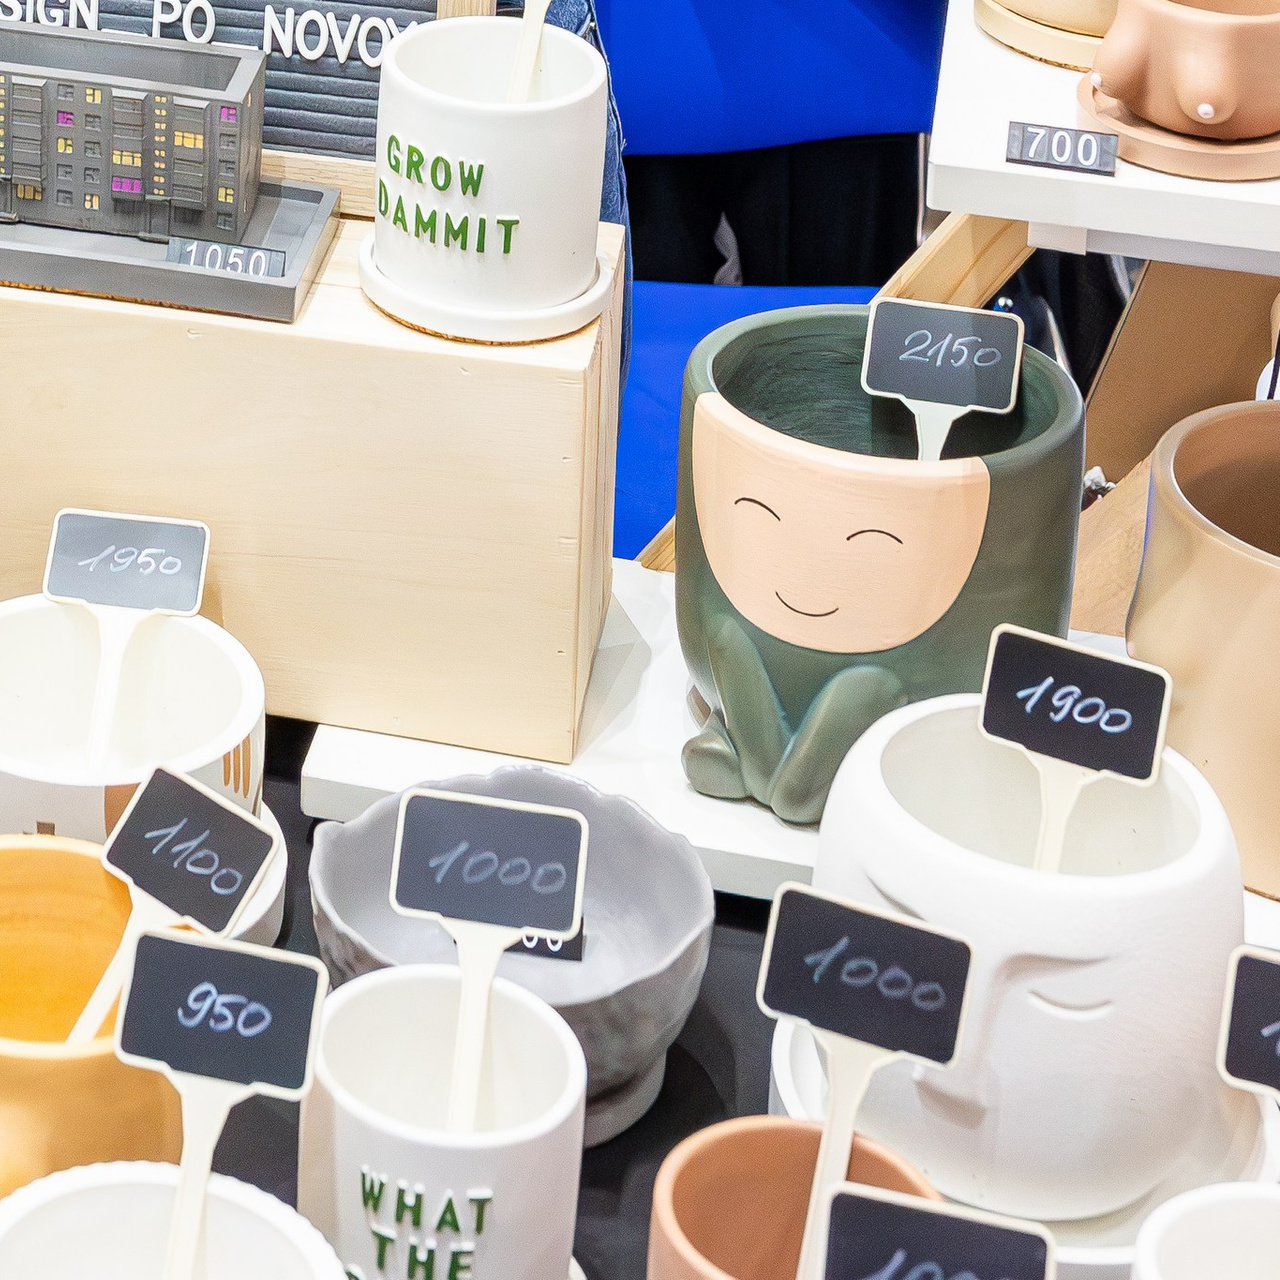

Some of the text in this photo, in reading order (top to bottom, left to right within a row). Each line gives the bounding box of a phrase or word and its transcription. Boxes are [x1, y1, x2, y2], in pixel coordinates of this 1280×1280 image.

[386, 134, 485, 198] GROW
[1025, 126, 1099, 167] 700
[377, 177, 521, 255] DAMMIT
[186, 243, 267, 278] 1050
[898, 329, 1003, 369] 2150
[77, 543, 183, 576] 1950
[1016, 675, 1133, 734] 1900
[144, 817, 244, 896] 1100
[427, 842, 567, 895] 1000
[802, 936, 948, 1011] 1000
[177, 981, 273, 1039] 950
[359, 1163, 495, 1236] WHAT
[371, 1223, 477, 1280] THE
